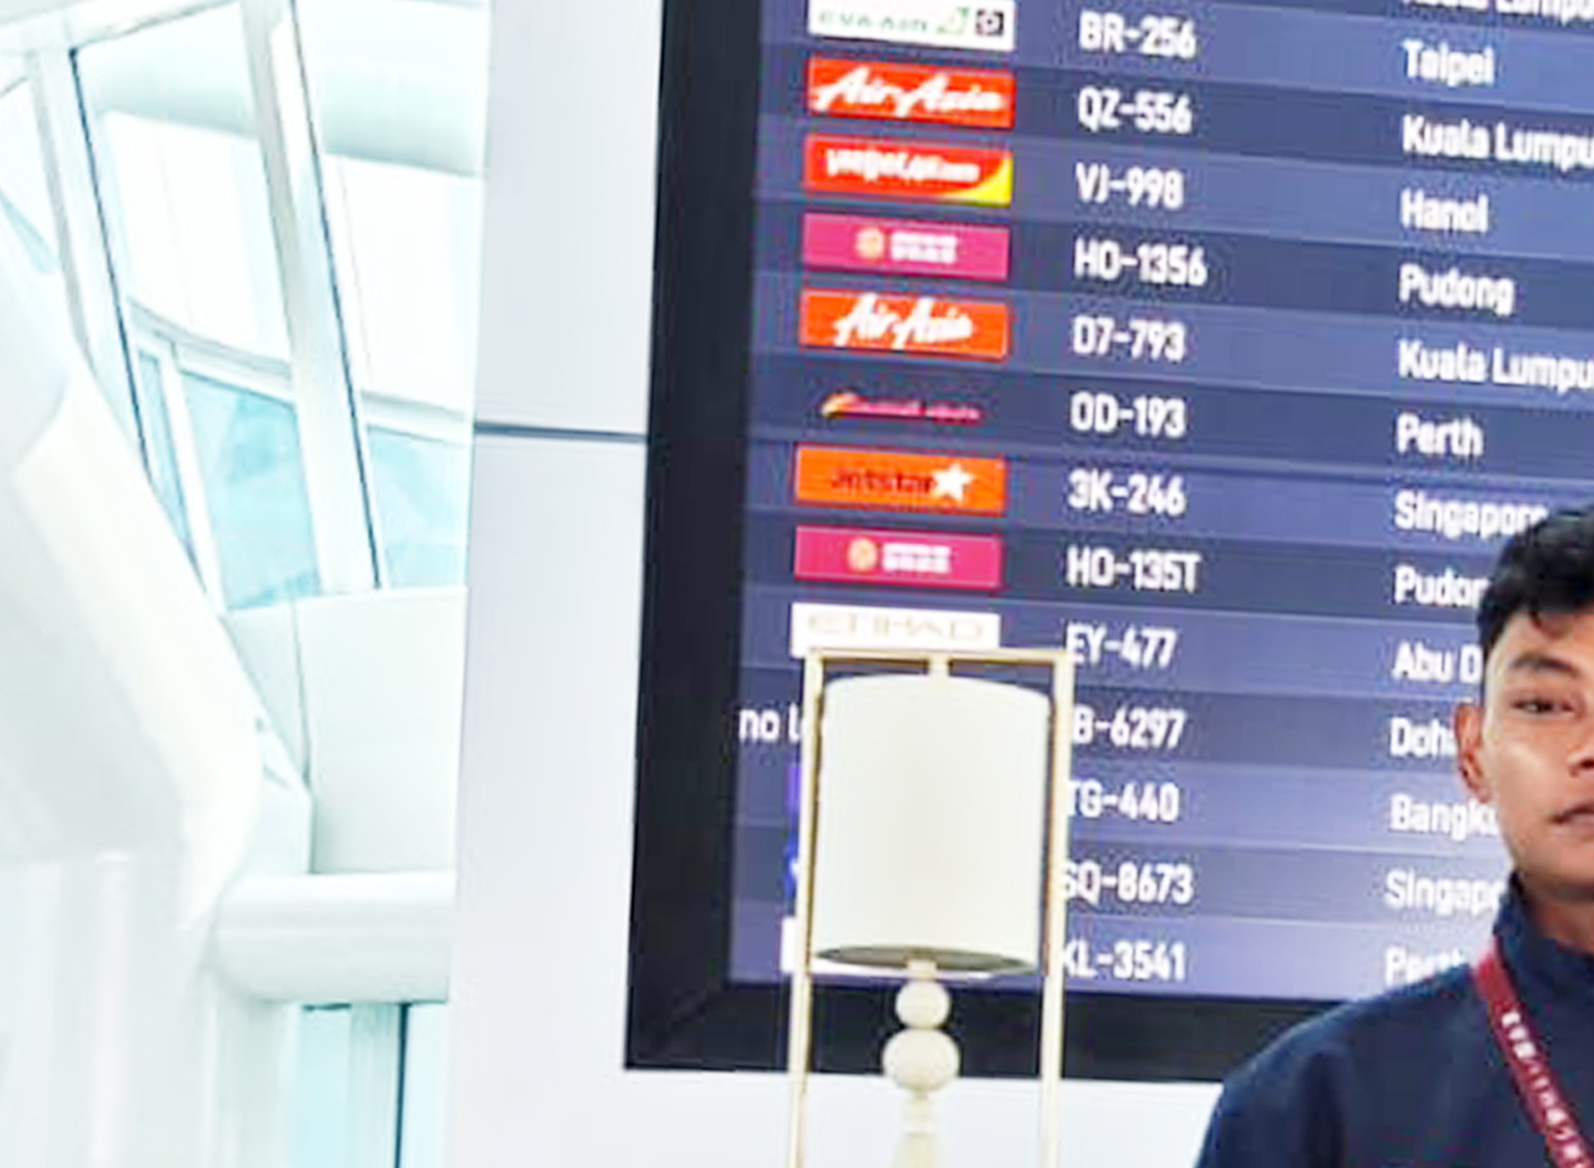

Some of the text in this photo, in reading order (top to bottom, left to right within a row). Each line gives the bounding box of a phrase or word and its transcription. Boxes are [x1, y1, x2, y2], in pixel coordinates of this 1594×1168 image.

[1079, 11, 1197, 58] BR-256
[1403, 39, 1495, 86] Taipei
[1078, 87, 1193, 134] QZ-556
[1402, 114, 1490, 159] Kuala
[1075, 162, 1184, 209] VJ-998
[1401, 189, 1489, 233] Hanoi
[1074, 238, 1208, 286] HO-1356
[1399, 263, 1515, 316] Pudong
[1073, 315, 1186, 361] D7-793
[1398, 340, 1488, 382] Kuala
[1071, 391, 1186, 438] OD-193
[1397, 413, 1483, 457] Perth
[1068, 469, 1186, 516] 3K-246
[1067, 546, 1201, 593] HO-135T
[1394, 565, 1489, 608] Pudon
[1066, 623, 1177, 668] EY-477
[1392, 642, 1454, 683] Abu
[739, 709, 780, 741] no
[1072, 705, 1187, 749] B-6297
[1390, 793, 1500, 842] Bangko
